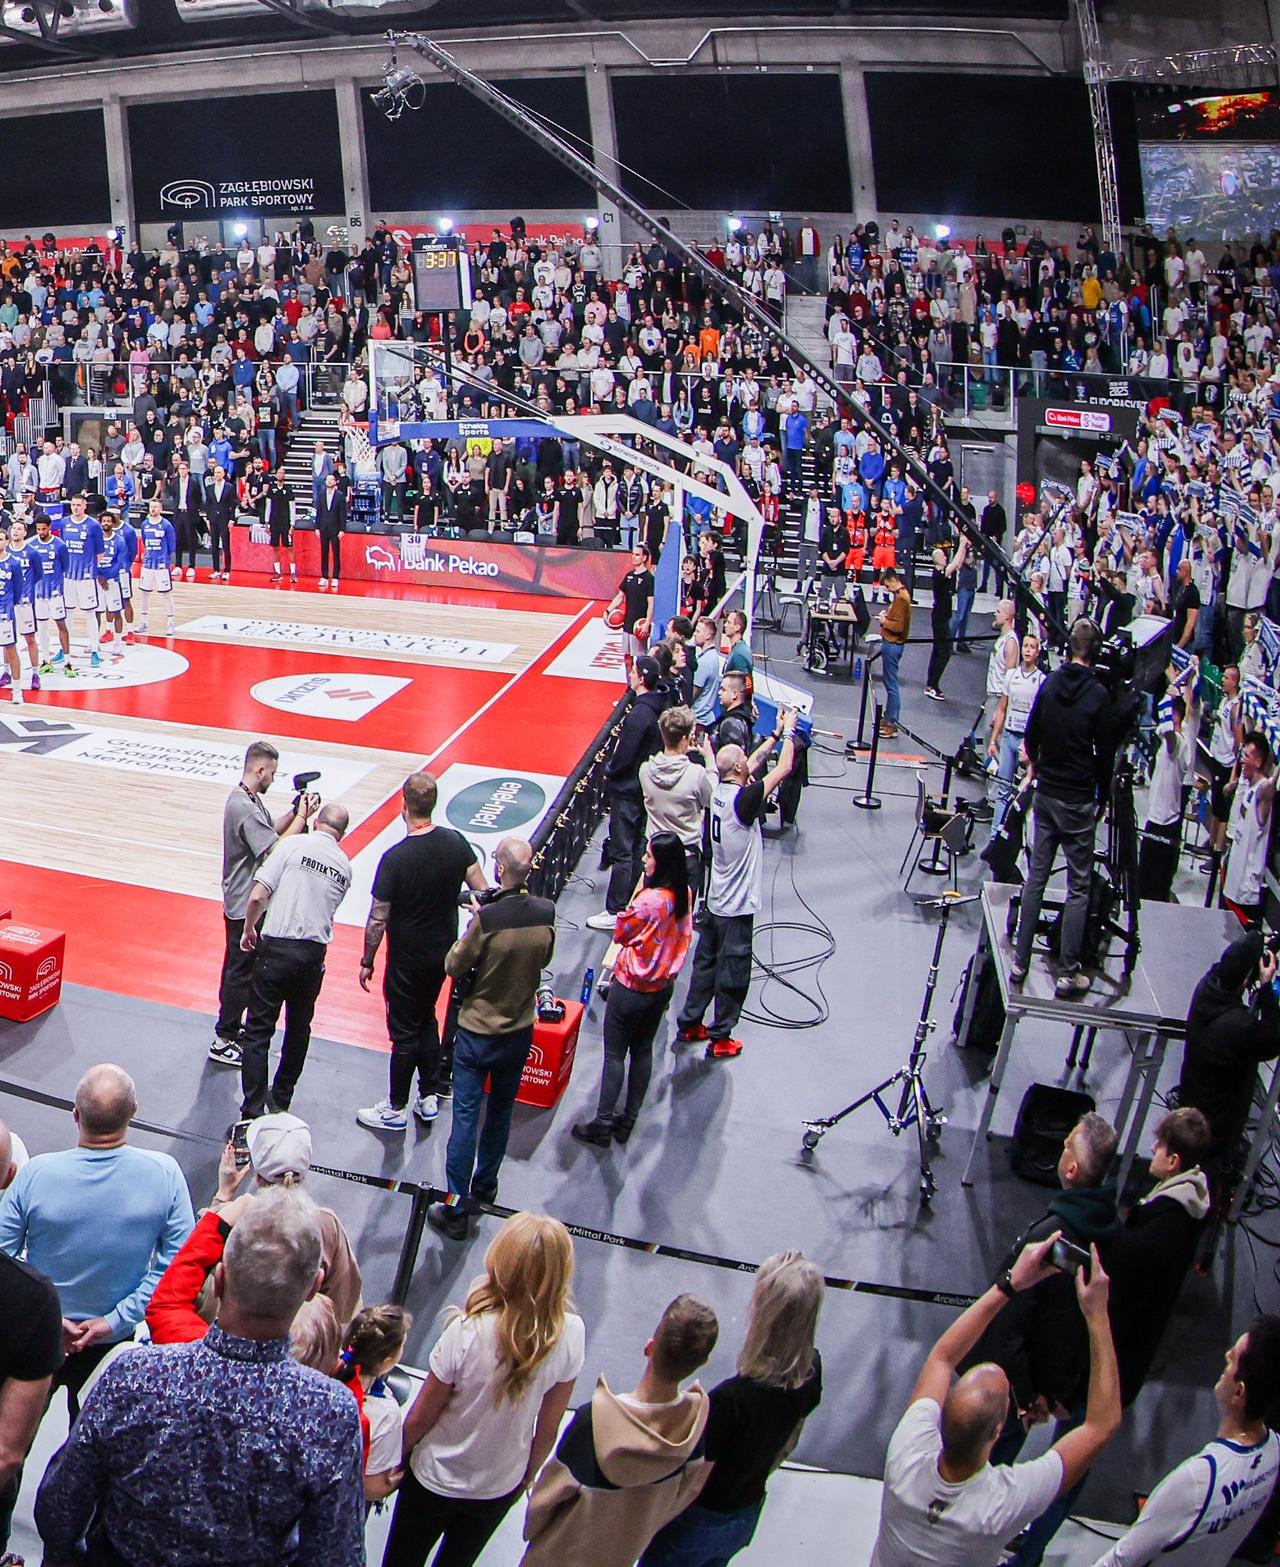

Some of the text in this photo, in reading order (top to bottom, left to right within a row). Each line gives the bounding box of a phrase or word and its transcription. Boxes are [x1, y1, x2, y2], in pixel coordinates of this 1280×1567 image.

[220, 179, 314, 194] ZAGŁĘBIOWSKI
[220, 194, 314, 207] PARK SPORTOWY
[426, 251, 457, 269] 3:37
[449, 556, 499, 577] Pekao
[274, 677, 331, 703] SUZUKI
[106, 738, 241, 762] Górnośląsk
[77, 751, 220, 777] Metropolia
[468, 781, 523, 829] enel-med
[346, 1173, 368, 1183] Park
[603, 1232, 625, 1246] Park
